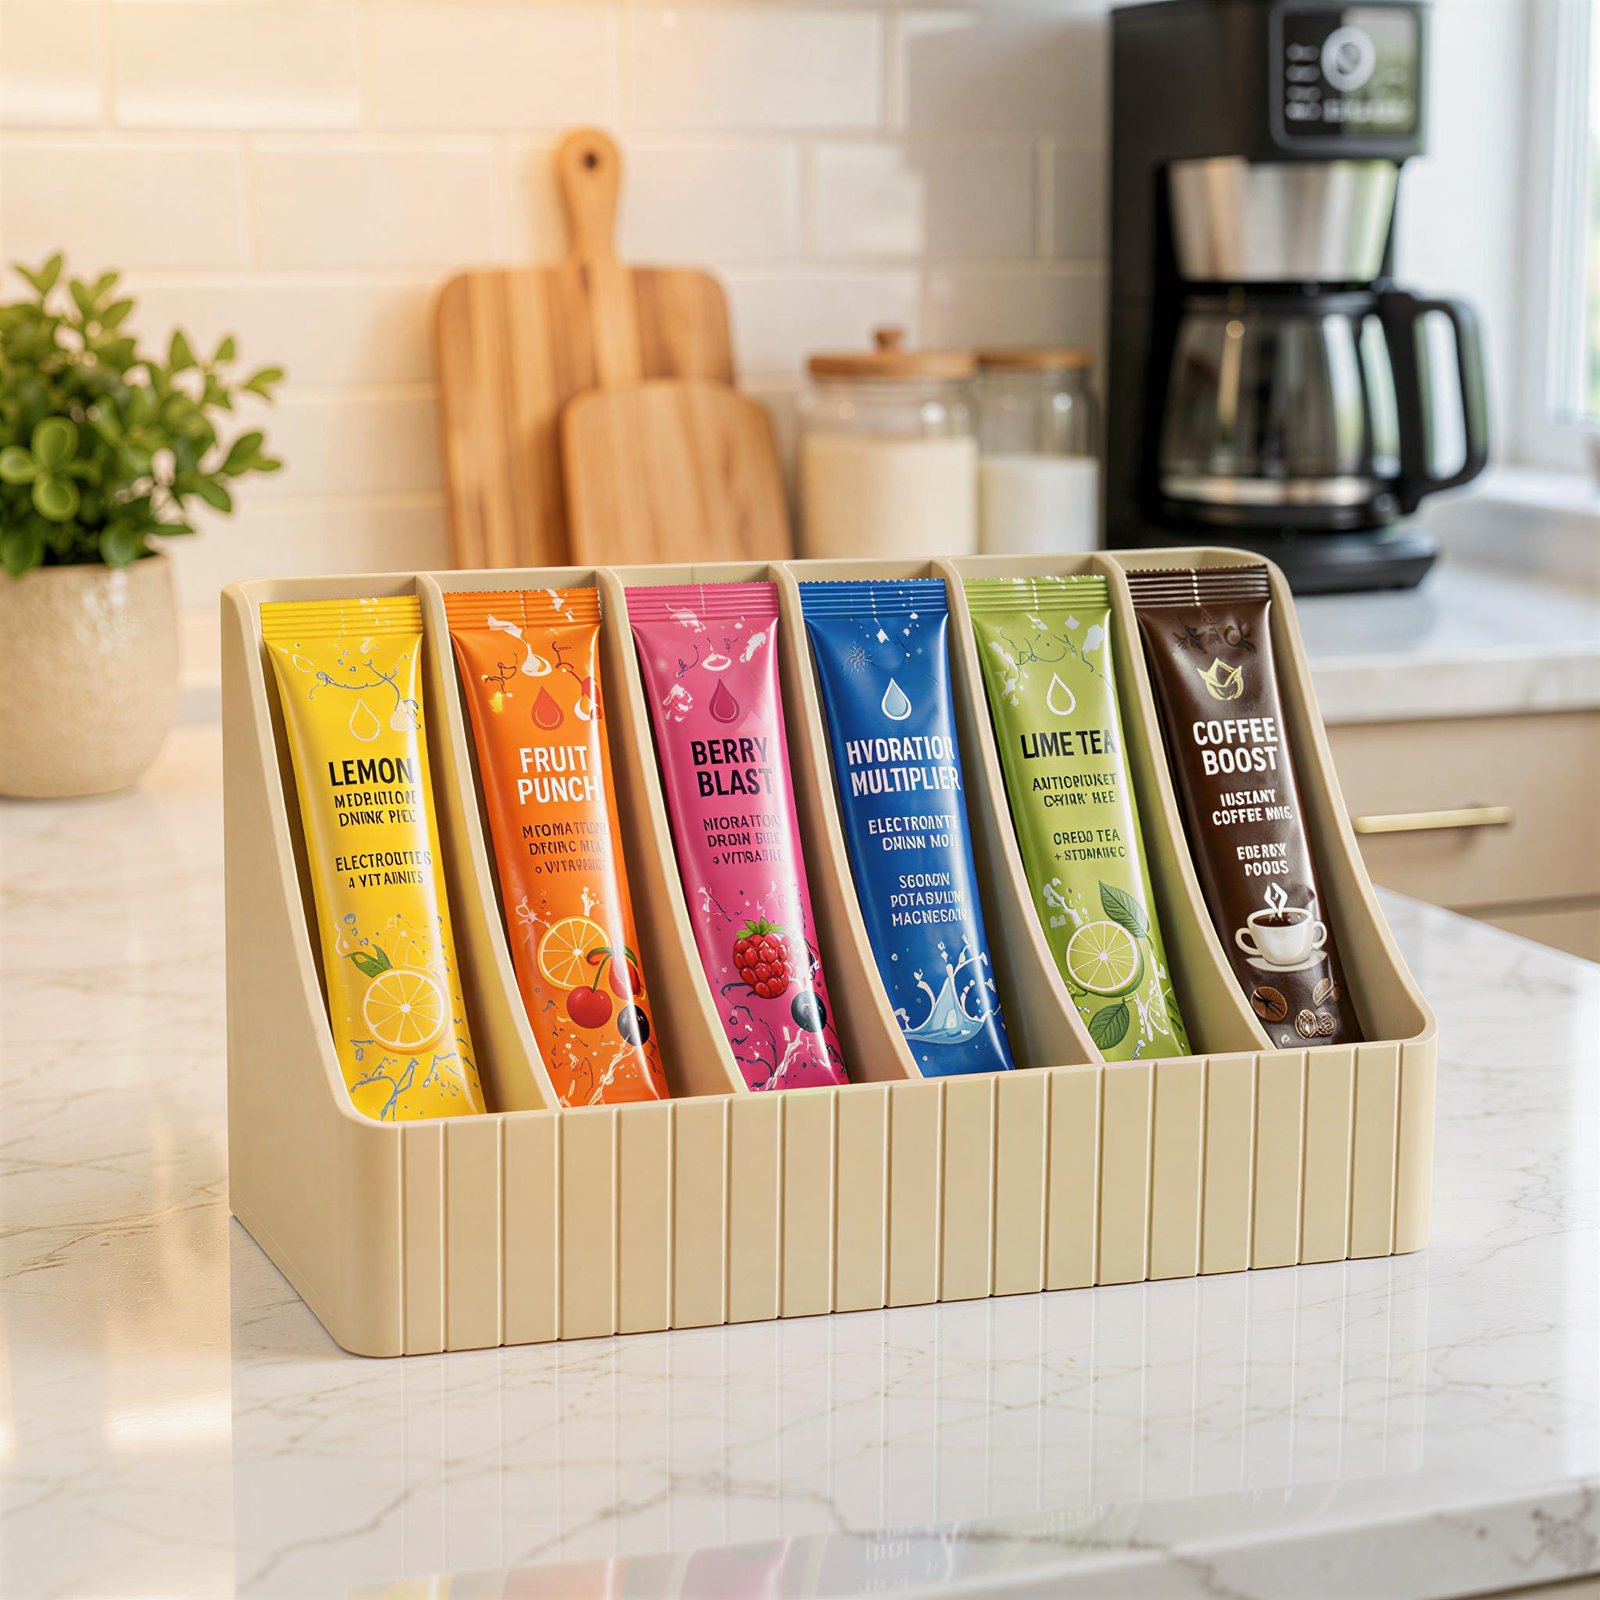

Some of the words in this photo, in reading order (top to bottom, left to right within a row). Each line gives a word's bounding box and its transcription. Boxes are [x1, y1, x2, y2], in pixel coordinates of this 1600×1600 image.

[1020, 731, 1074, 759] LIME
[1076, 730, 1118, 755] TEA
[1193, 717, 1278, 745] COFFEE
[519, 745, 588, 773] FRUIT
[691, 737, 767, 766] BERRY
[1201, 746, 1278, 775] BOOST
[328, 758, 414, 786] LEMON
[696, 768, 772, 797] BLAST
[850, 766, 961, 797] MULTIPLIER
[517, 776, 601, 805] PUNCH
[1212, 808, 1263, 825] COFFEE
[1096, 829, 1120, 841] TEA
